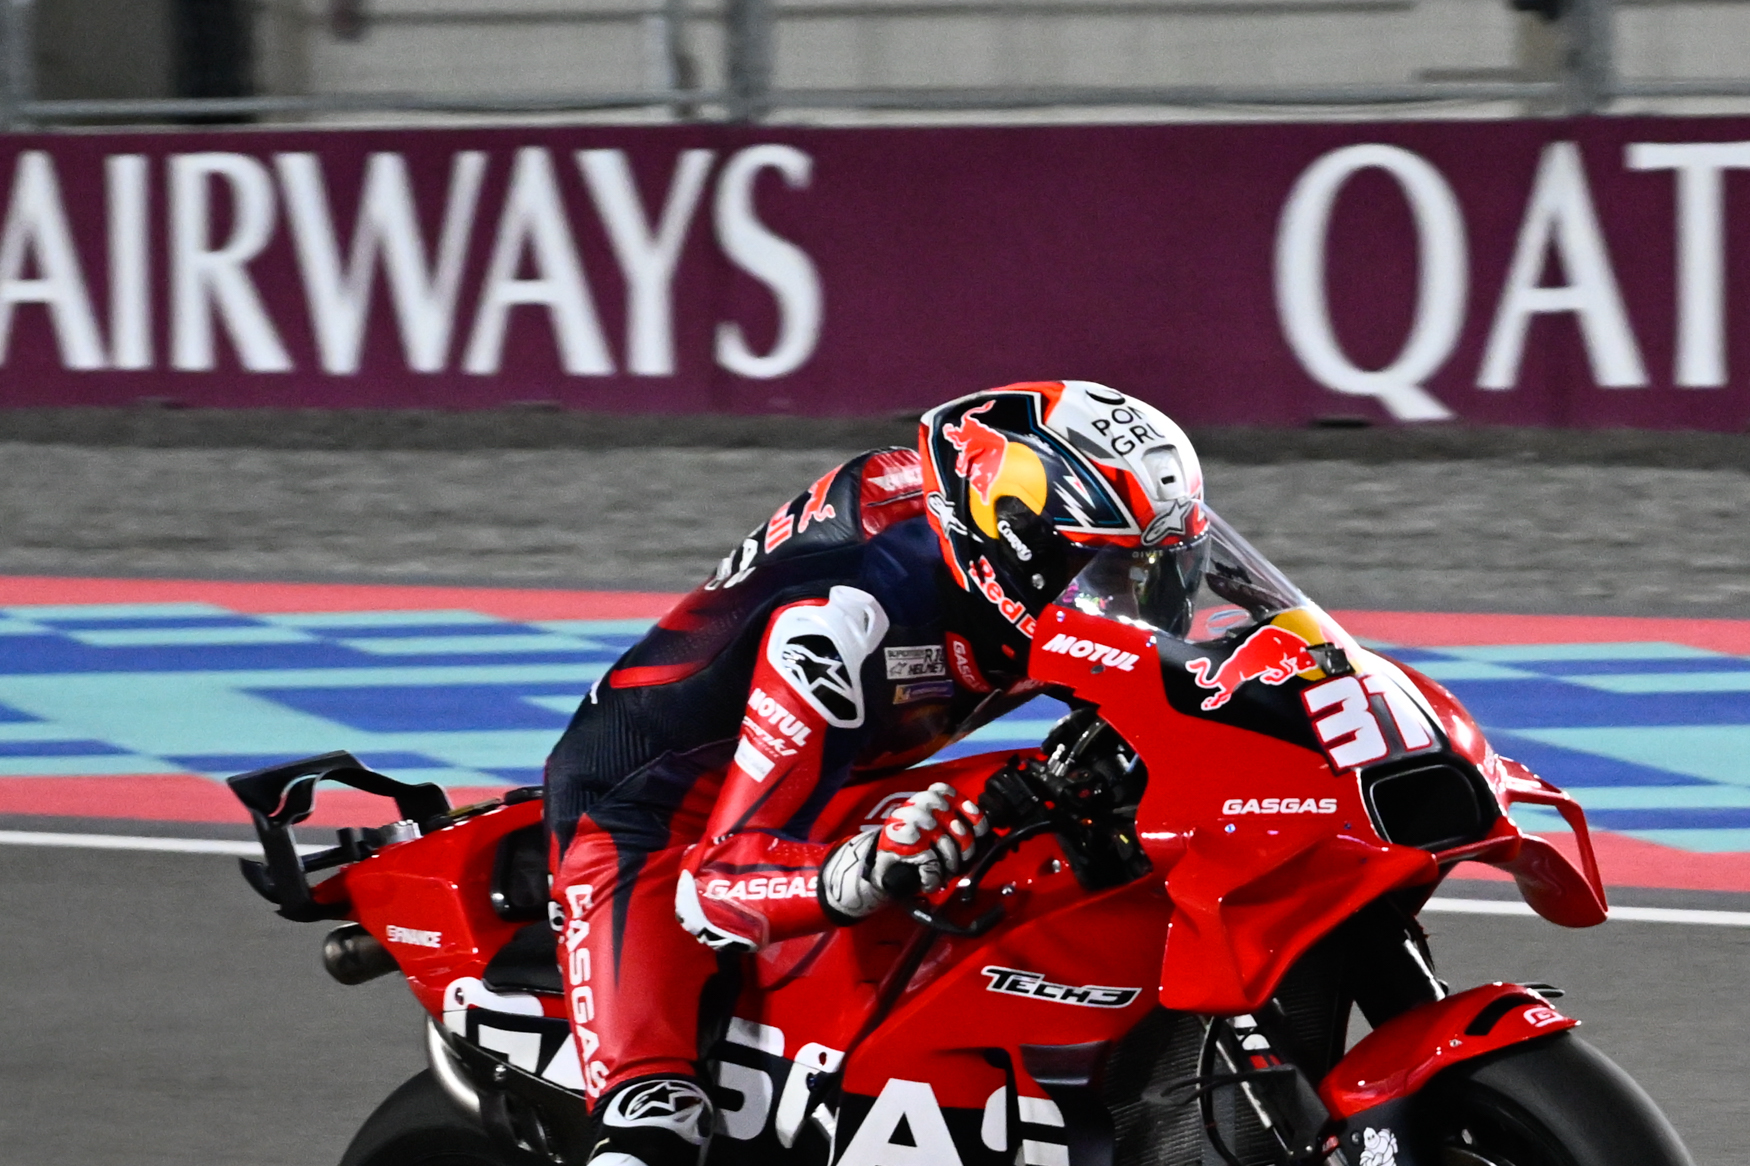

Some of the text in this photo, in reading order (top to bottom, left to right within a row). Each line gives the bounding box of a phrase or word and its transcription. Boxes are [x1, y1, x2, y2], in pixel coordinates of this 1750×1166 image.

[0, 144, 822, 379] AIRWAYS
[1042, 633, 1140, 672] MOTUL
[747, 687, 812, 747] MOTUL
[1304, 673, 1433, 776] 31
[1222, 798, 1337, 816] GASGAS
[564, 883, 610, 1099] GASGAS
[982, 965, 1142, 1009] TECH3
